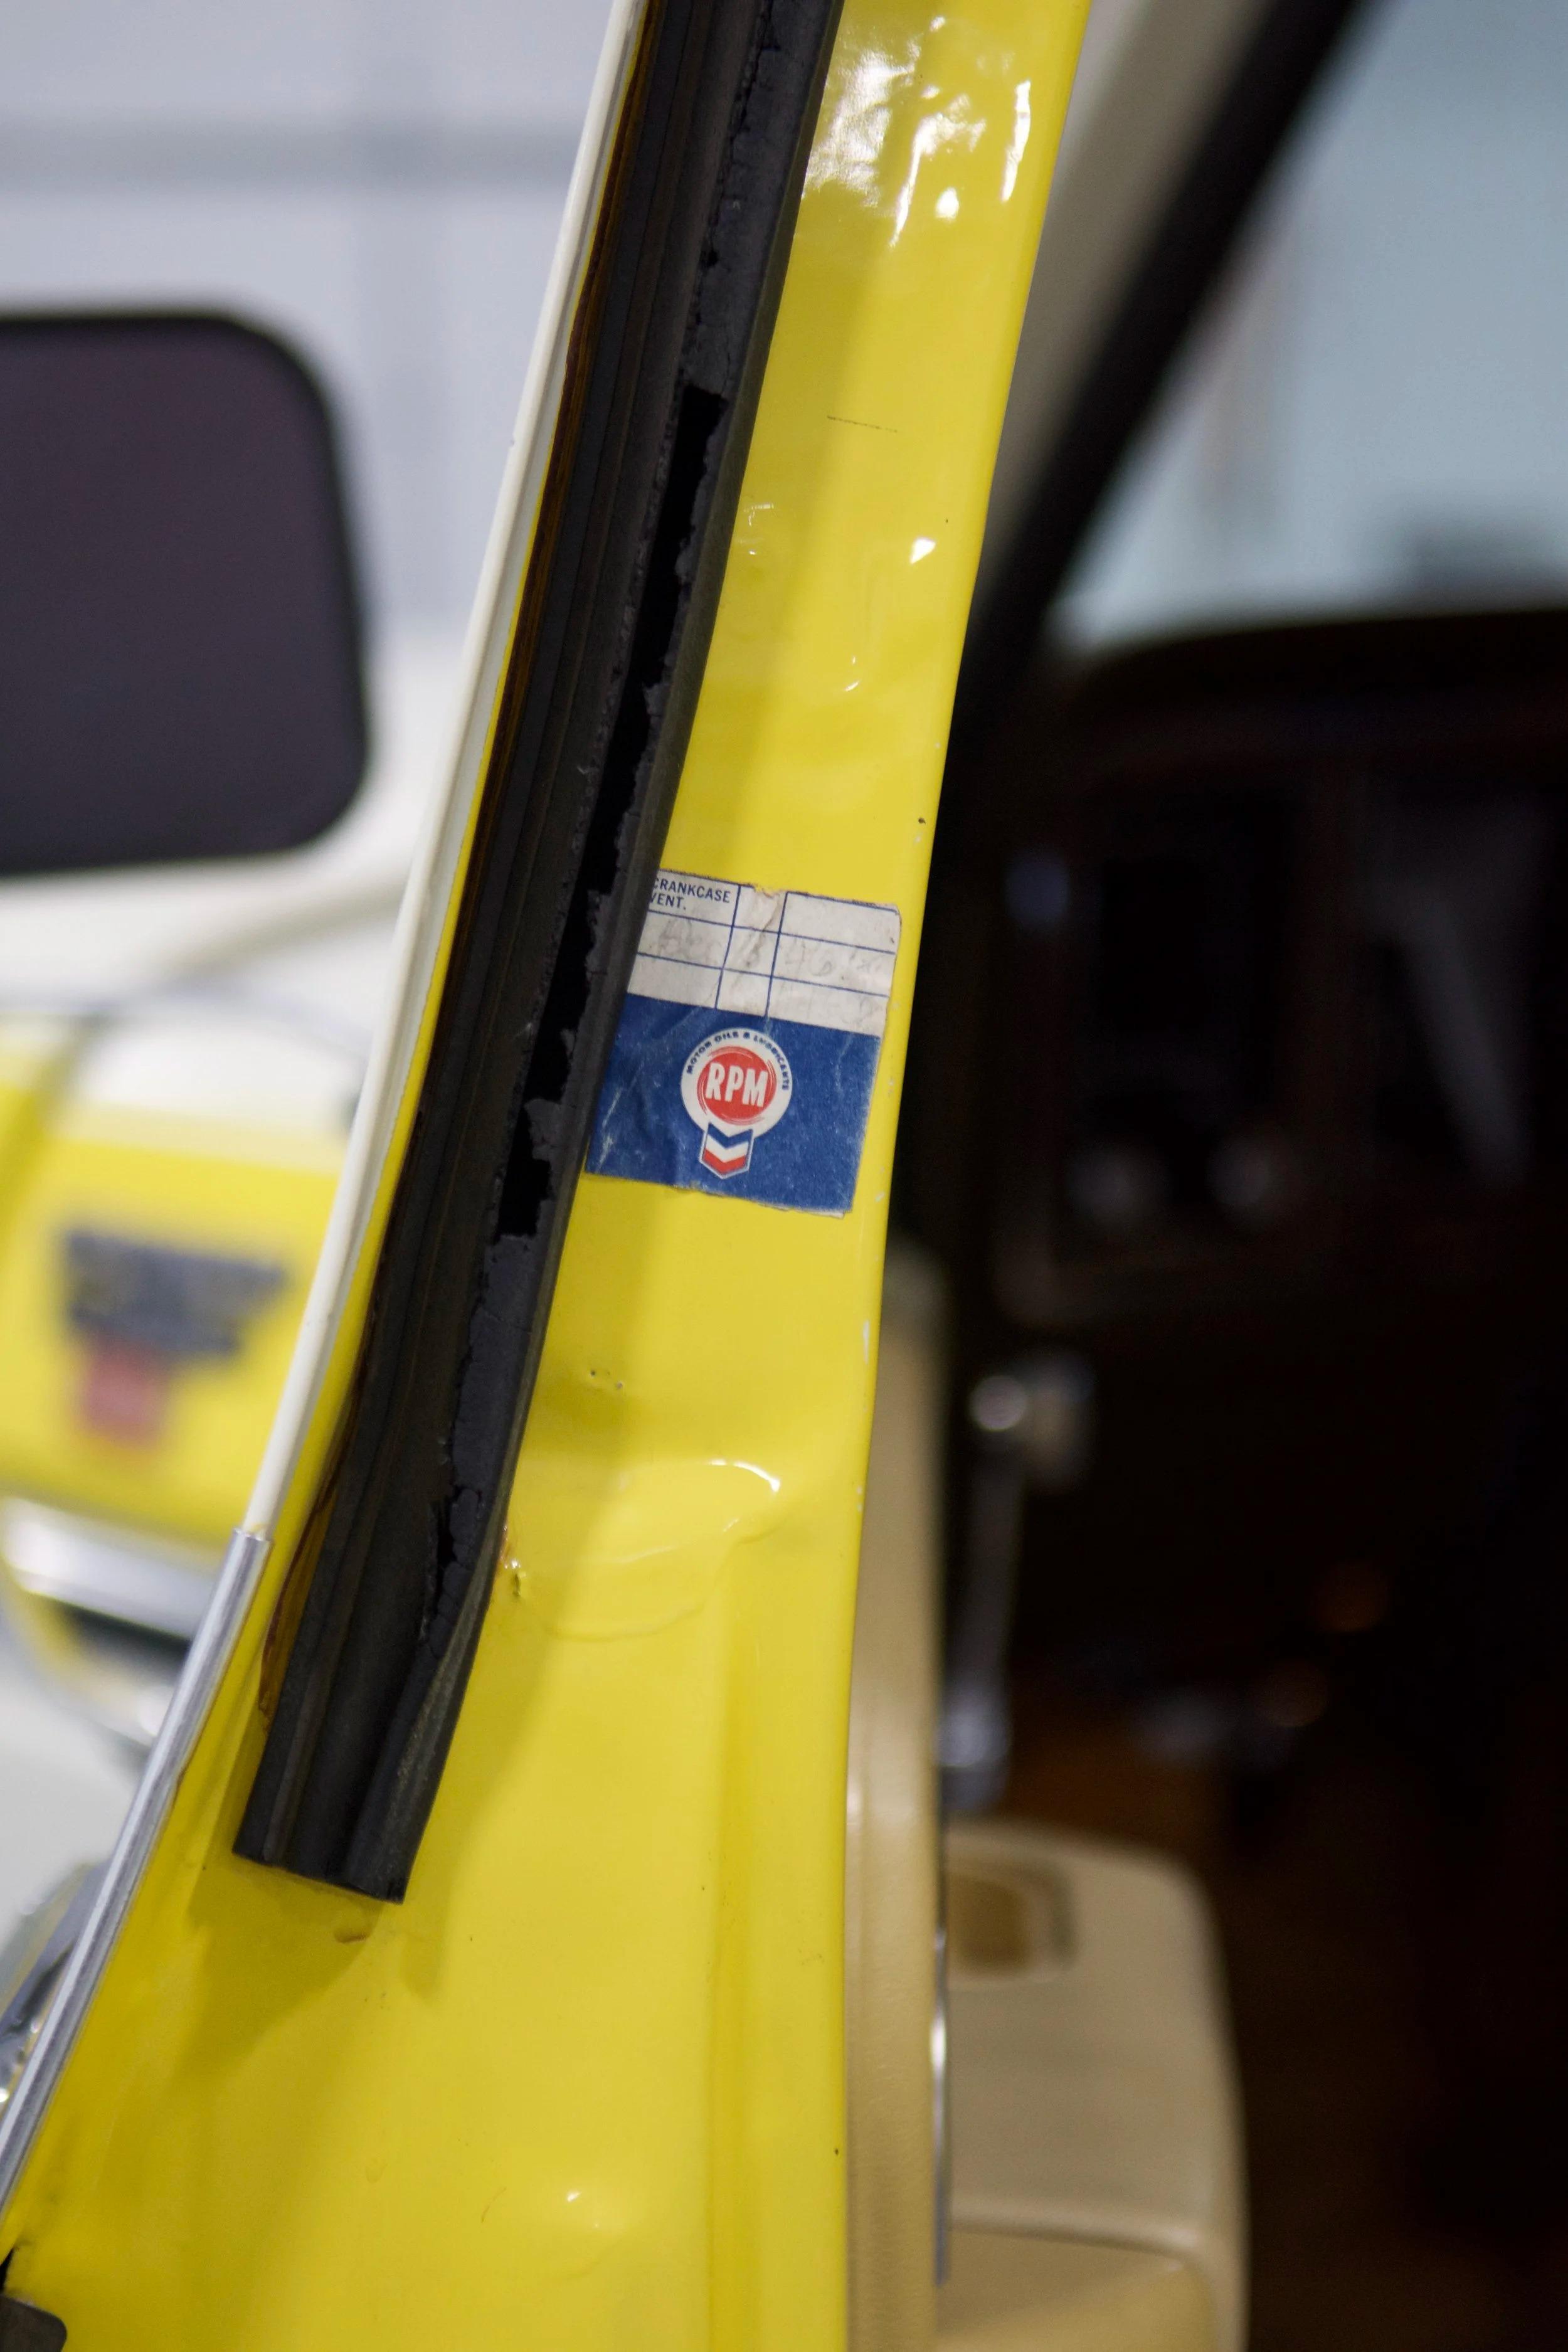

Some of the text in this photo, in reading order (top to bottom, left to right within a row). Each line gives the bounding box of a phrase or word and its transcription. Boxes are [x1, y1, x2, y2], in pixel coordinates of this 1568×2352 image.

[686, 1041, 712, 1074] MOTOR
[714, 1031, 739, 1042] OILS
[753, 1034, 790, 1091] LUBRICANTS
[705, 1061, 769, 1108] RPM
